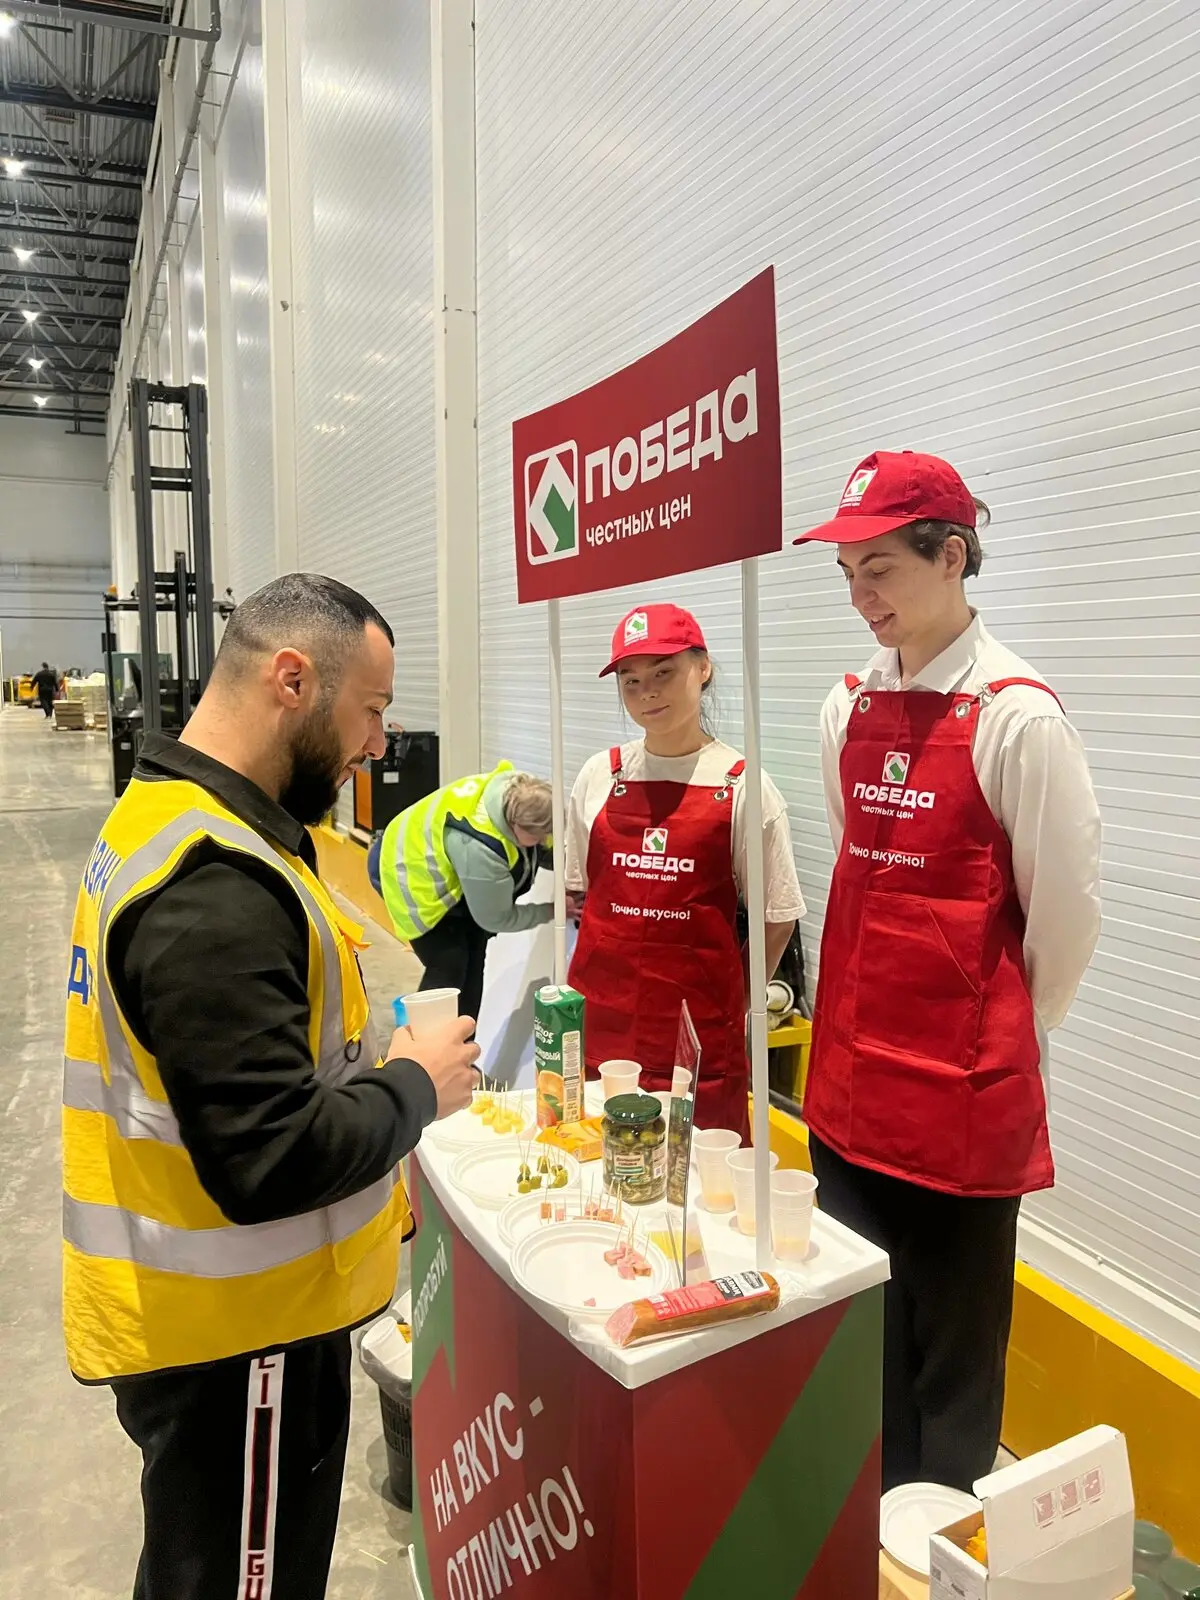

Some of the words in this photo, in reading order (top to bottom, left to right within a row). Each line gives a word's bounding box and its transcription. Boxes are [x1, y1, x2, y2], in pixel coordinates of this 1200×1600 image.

[586, 508, 655, 547] честных
[659, 493, 692, 530] цен
[861, 804, 895, 817] честных
[896, 810, 914, 820] цен
[849, 842, 869, 858] Точно
[871, 850, 925, 869] вкусно!
[625, 871, 659, 881] честных
[660, 873, 678, 882] цен
[610, 902, 641, 917] Точно
[642, 908, 691, 921] вкусно!
[413, 1232, 448, 1339] ПОПРОБУЙ
[429, 1457, 460, 1533] НА
[452, 1391, 524, 1506] ВКУС
[446, 1464, 596, 1600] ОТЛИЧНО!
